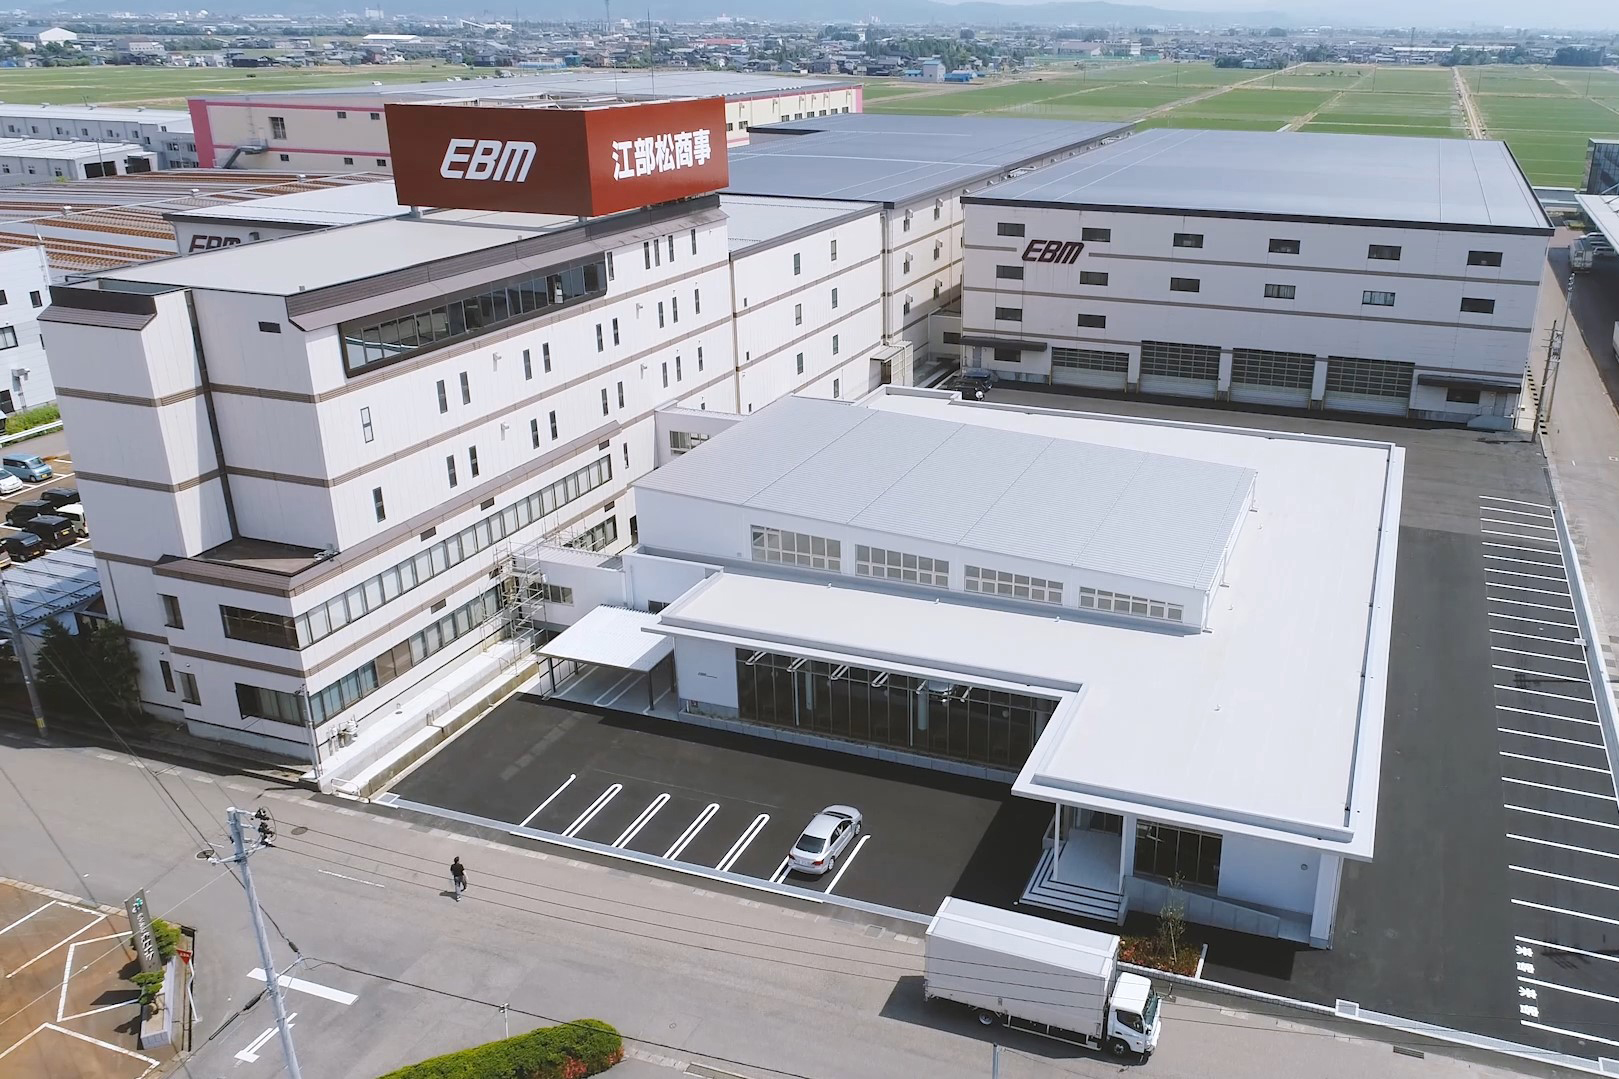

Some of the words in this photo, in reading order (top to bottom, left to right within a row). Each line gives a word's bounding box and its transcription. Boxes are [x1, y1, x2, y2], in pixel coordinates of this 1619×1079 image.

[440, 138, 537, 183] EBM
[611, 128, 711, 181] 江部松商事
[1021, 239, 1085, 265] EBM
